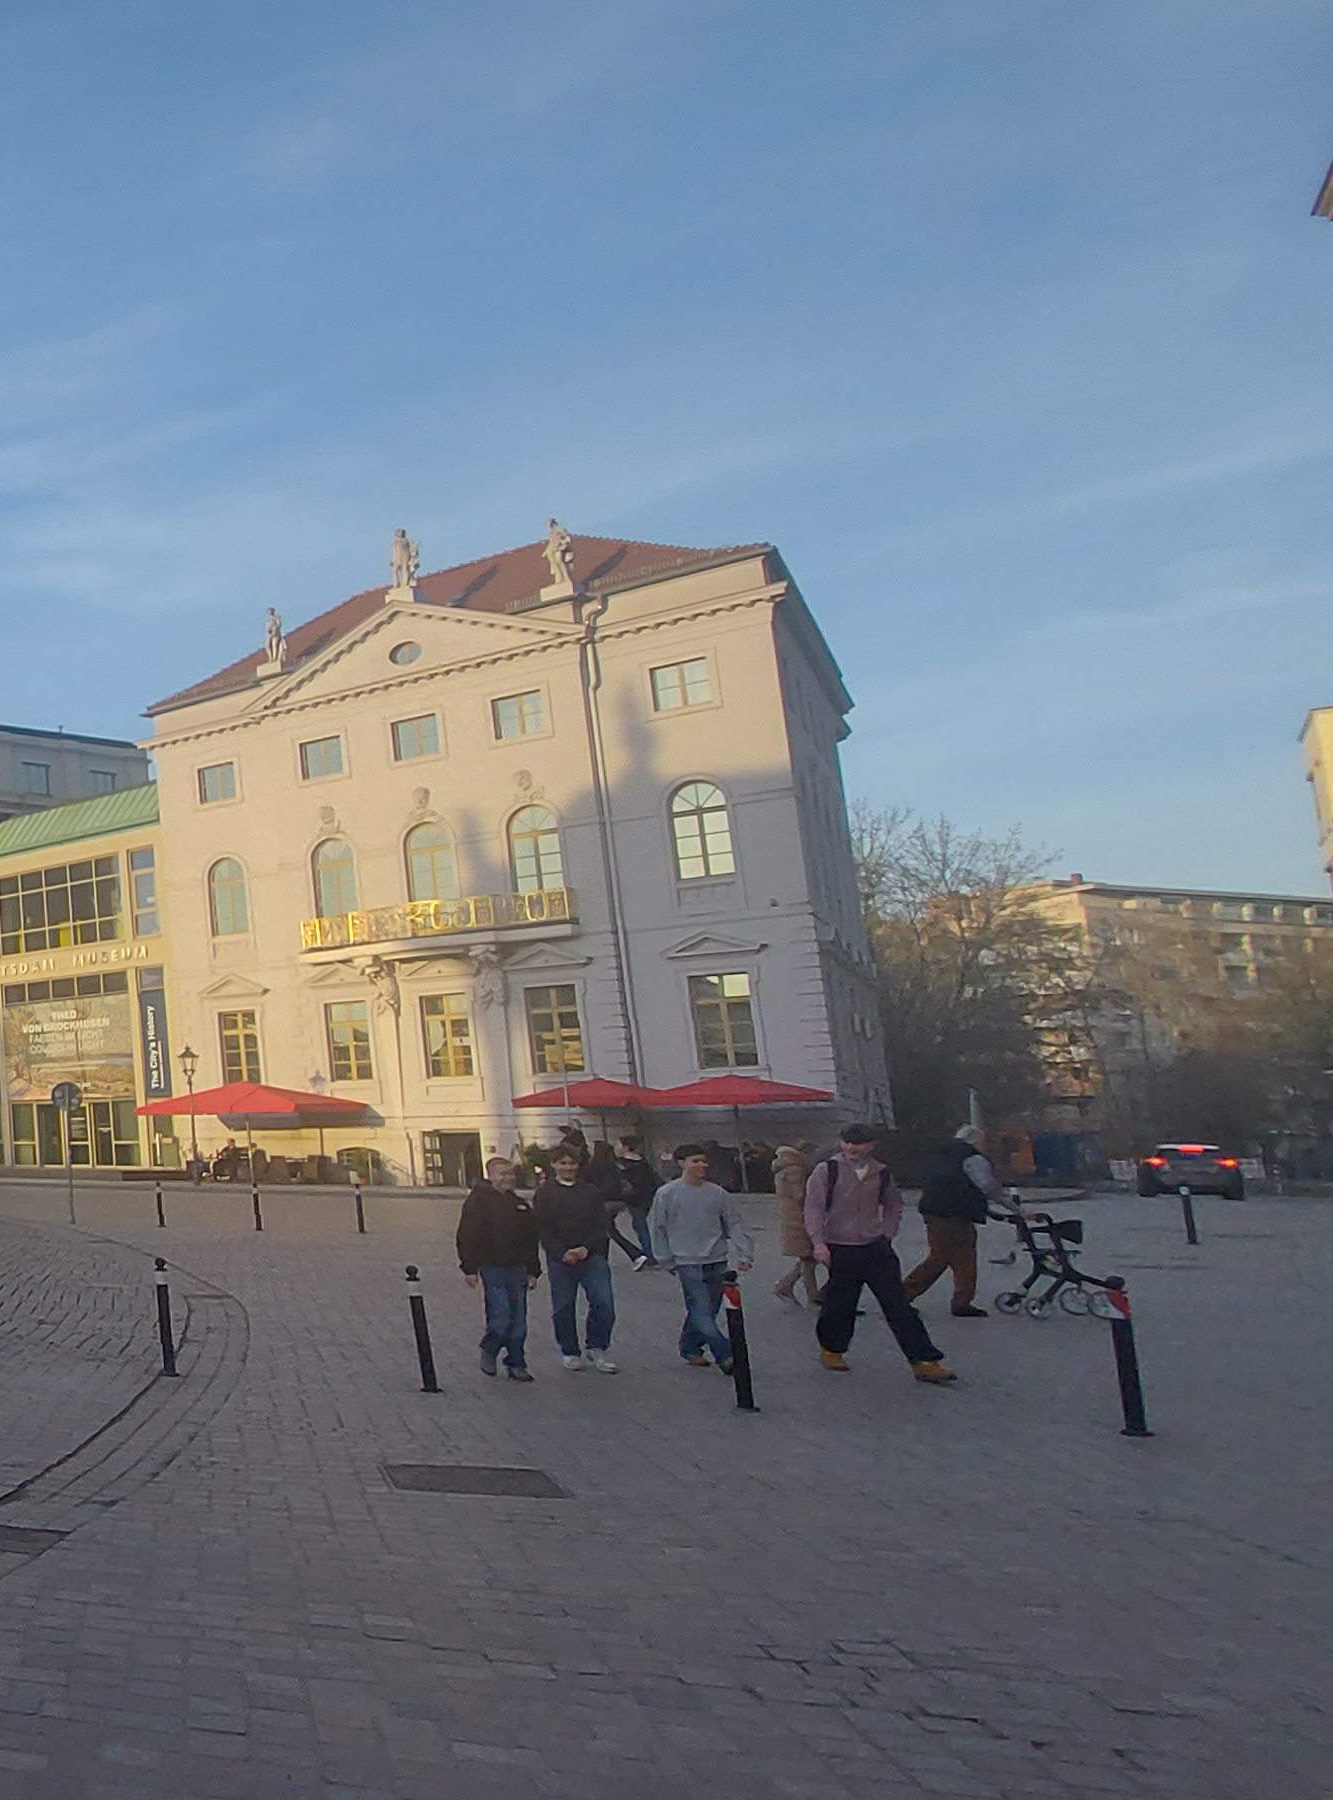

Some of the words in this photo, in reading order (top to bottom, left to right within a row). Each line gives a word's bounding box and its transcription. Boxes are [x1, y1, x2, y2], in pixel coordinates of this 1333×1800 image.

[73, 945, 148, 967] MUSEUM
[52, 1010, 77, 1020] THEO
[147, 1005, 157, 1040] History
[22, 1024, 42, 1034] VON
[44, 1017, 110, 1032] BROCKHUSEN
[151, 1069, 160, 1089] The
